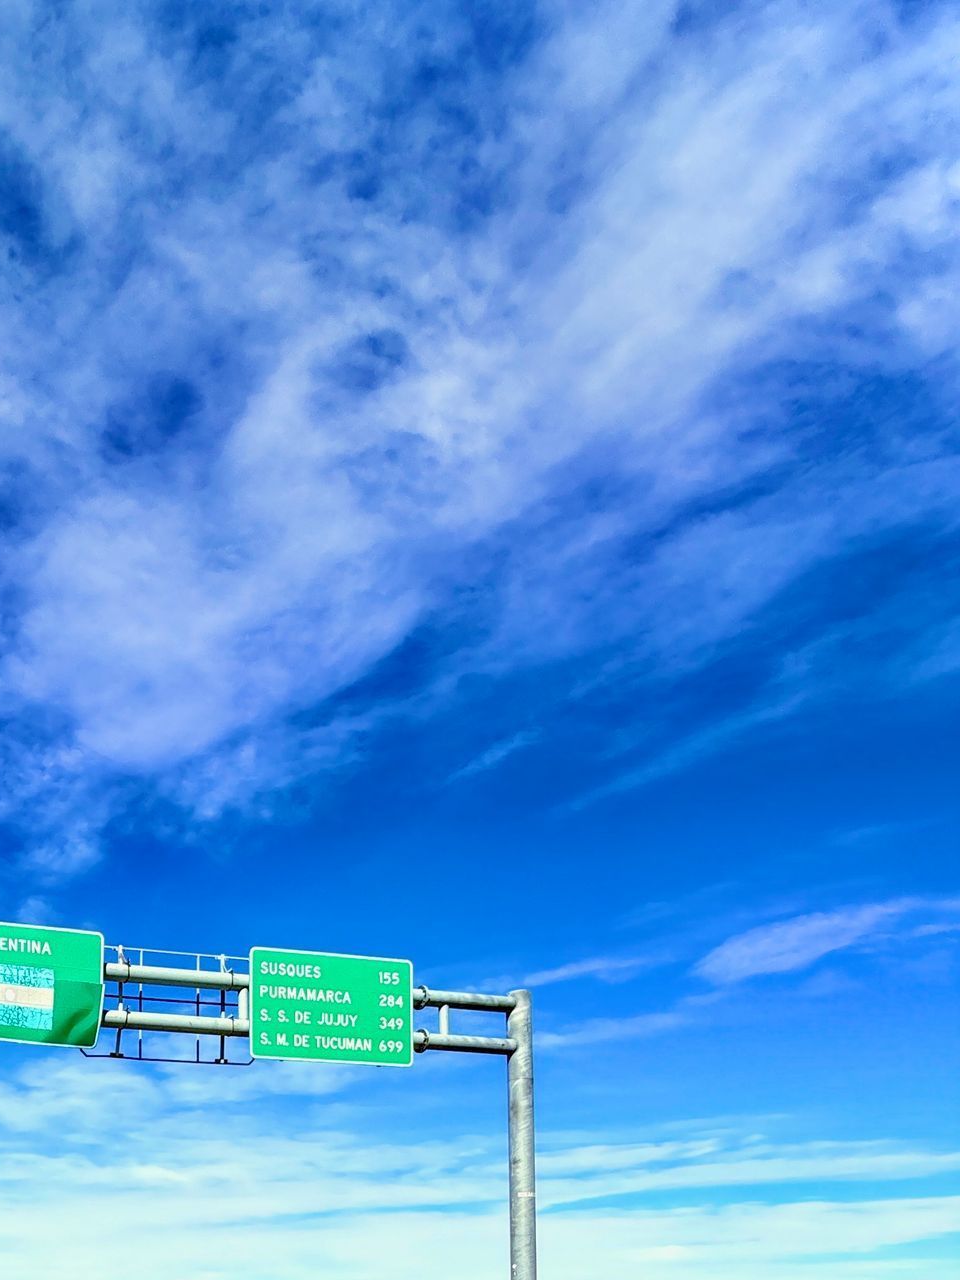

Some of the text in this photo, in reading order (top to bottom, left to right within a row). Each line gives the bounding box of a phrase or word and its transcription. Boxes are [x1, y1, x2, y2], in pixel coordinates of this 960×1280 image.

[260, 961, 400, 985] SUSQUES 155
[259, 985, 404, 1008] PURMAMARCA 284
[260, 1009, 404, 1030] S. S. DE JUJUY 349
[260, 1032, 404, 1053] S. M. DE TUCUMAN 699
